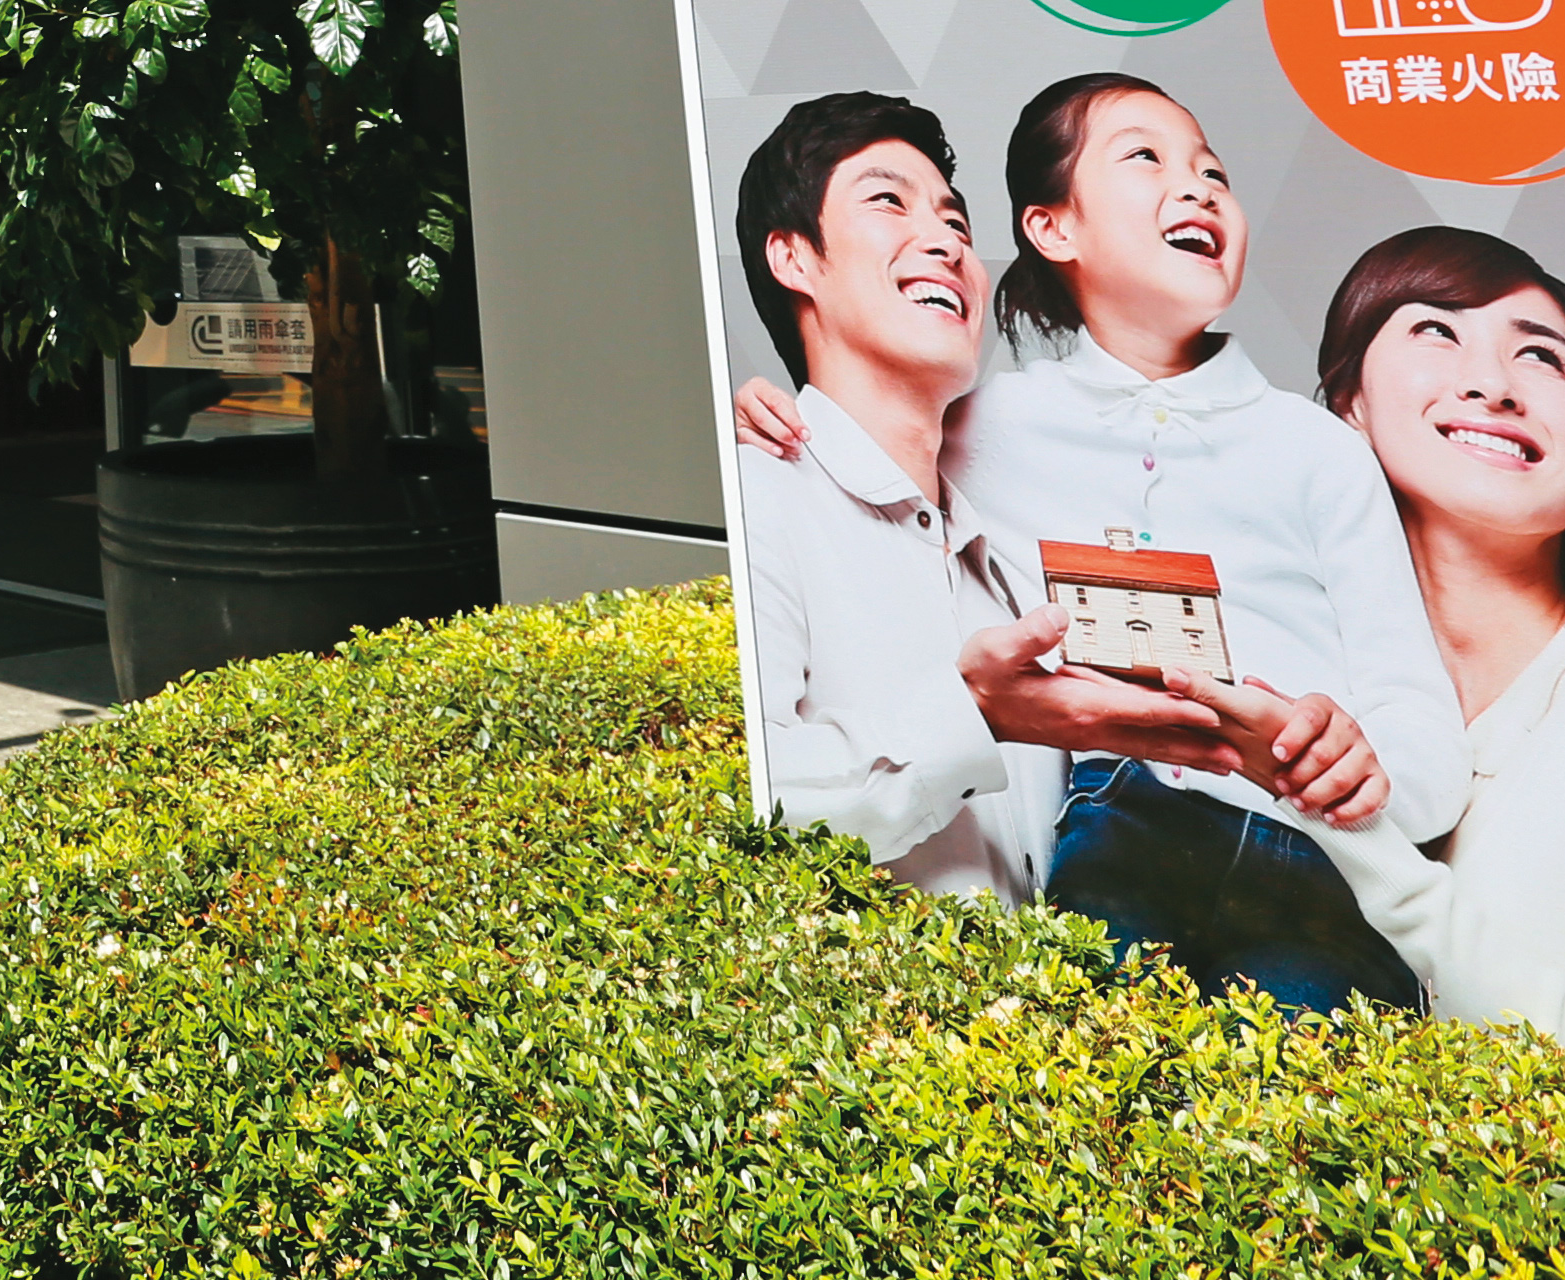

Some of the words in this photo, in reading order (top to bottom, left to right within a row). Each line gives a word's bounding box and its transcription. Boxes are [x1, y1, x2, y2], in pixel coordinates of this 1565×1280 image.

[1340, 51, 1562, 108] 商業火險
[227, 318, 306, 340] 請用雨傘套
